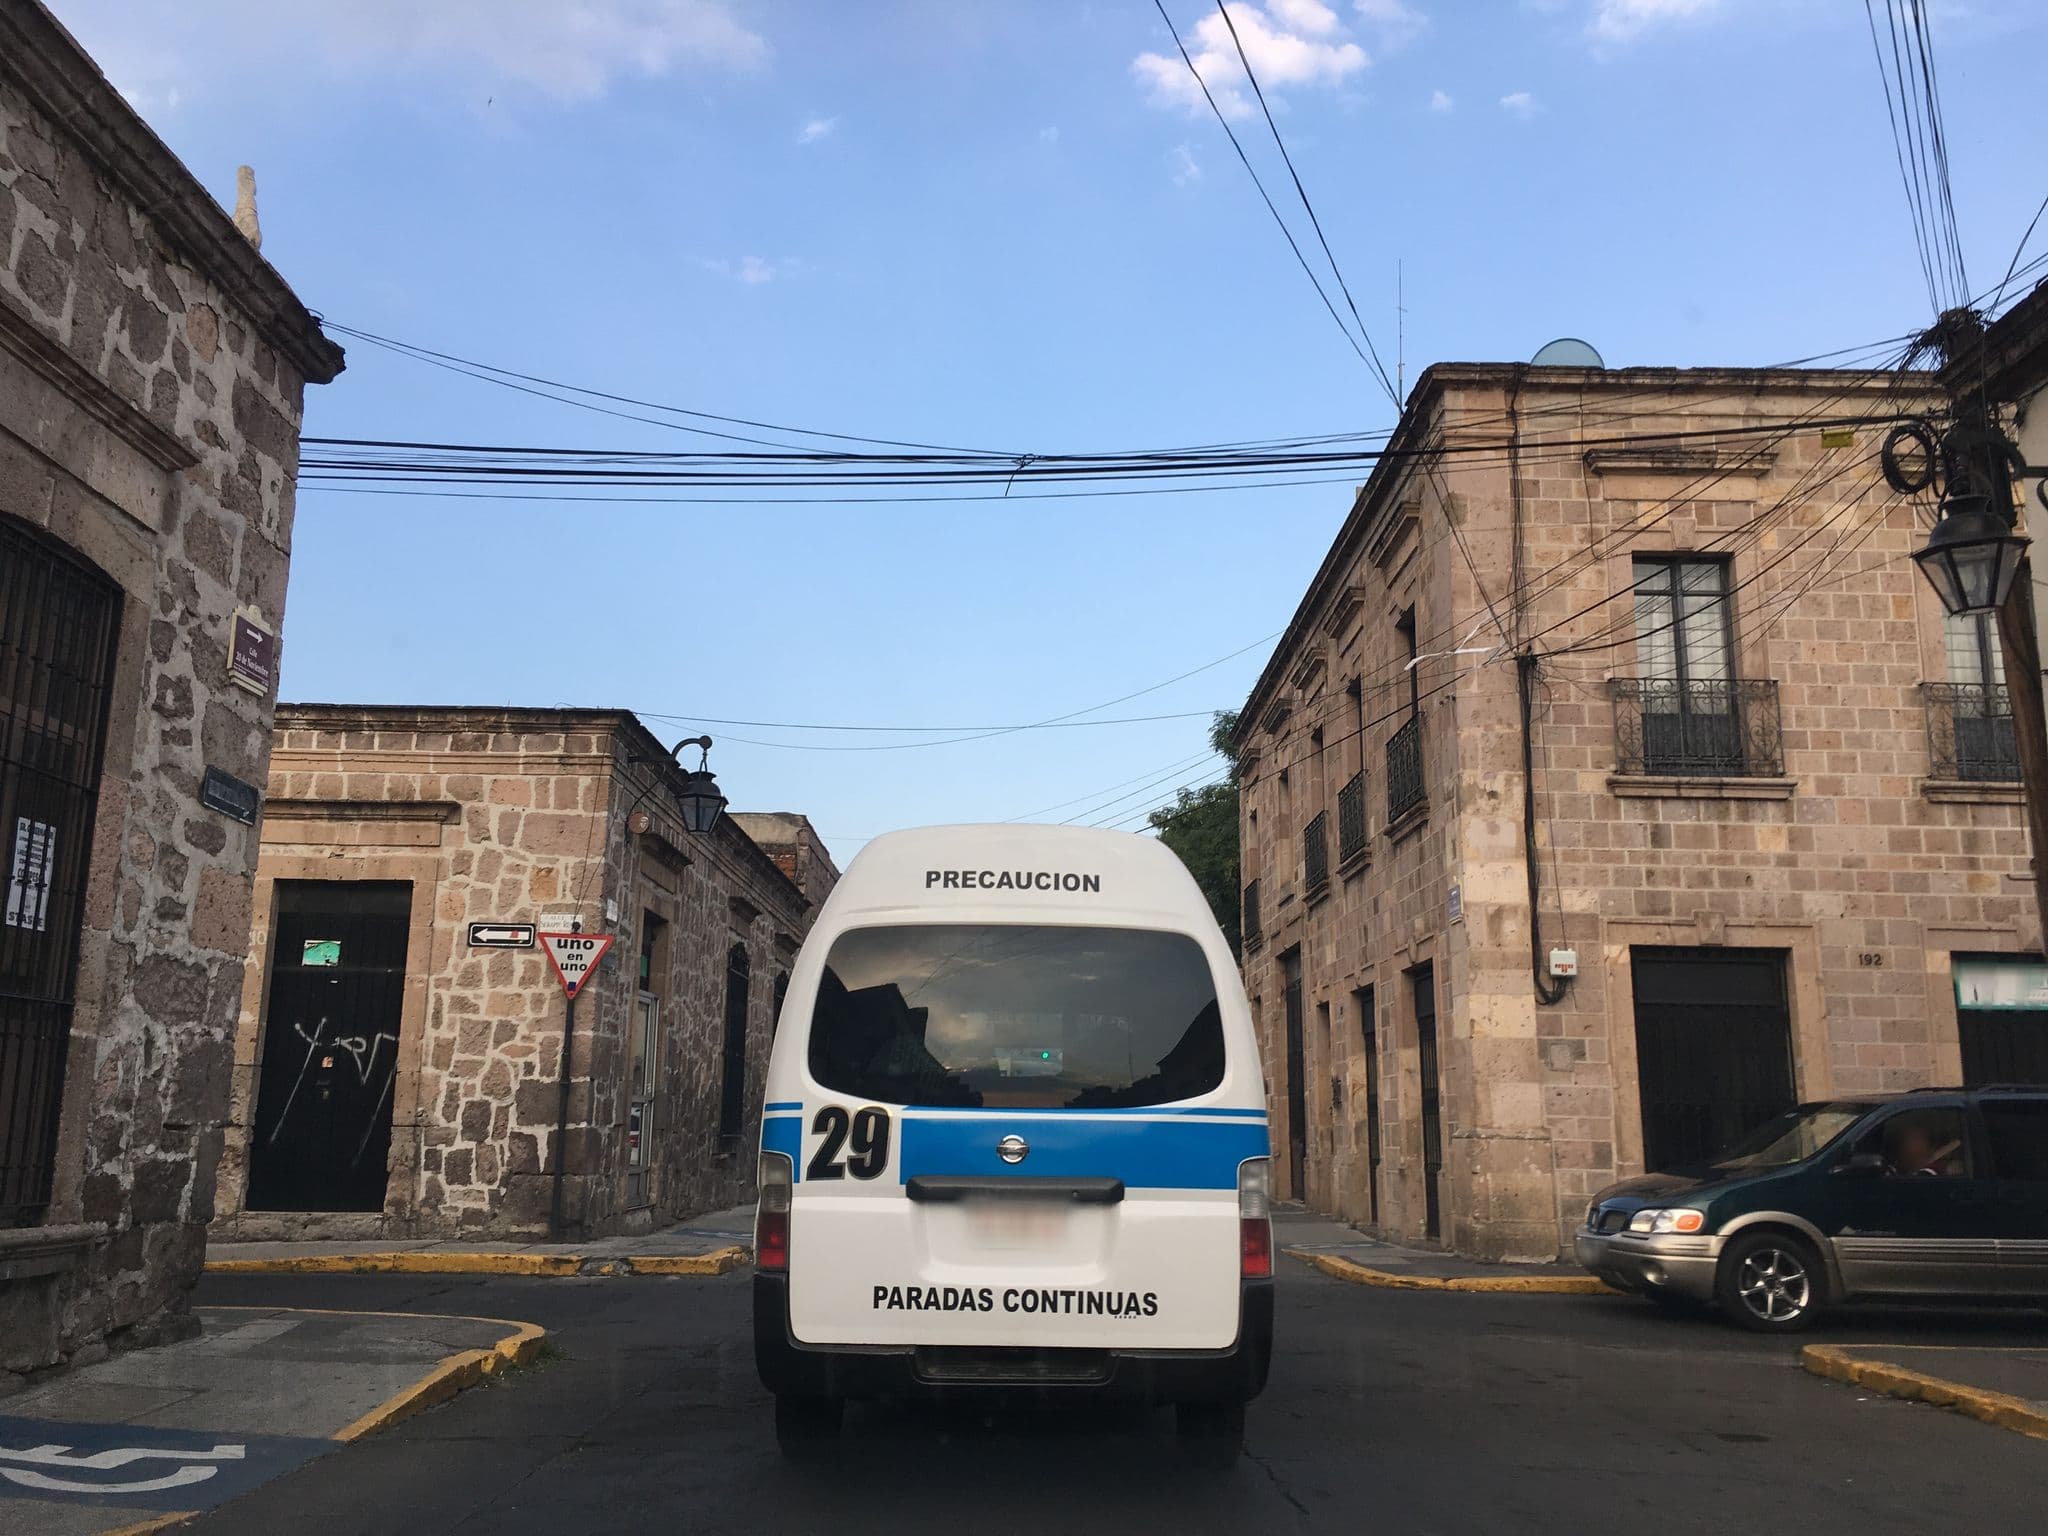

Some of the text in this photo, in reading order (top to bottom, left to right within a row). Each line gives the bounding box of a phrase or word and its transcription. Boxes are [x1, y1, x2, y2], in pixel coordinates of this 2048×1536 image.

[247, 657, 269, 678] Noviembre
[925, 870, 1100, 892] PRECAUCION
[557, 938, 595, 950] uno
[567, 953, 583, 961] en
[1859, 953, 1883, 966] 192
[560, 962, 588, 972] uno
[806, 1104, 893, 1181] 29
[873, 1285, 1159, 1317] PARADAS CONTINUAS
